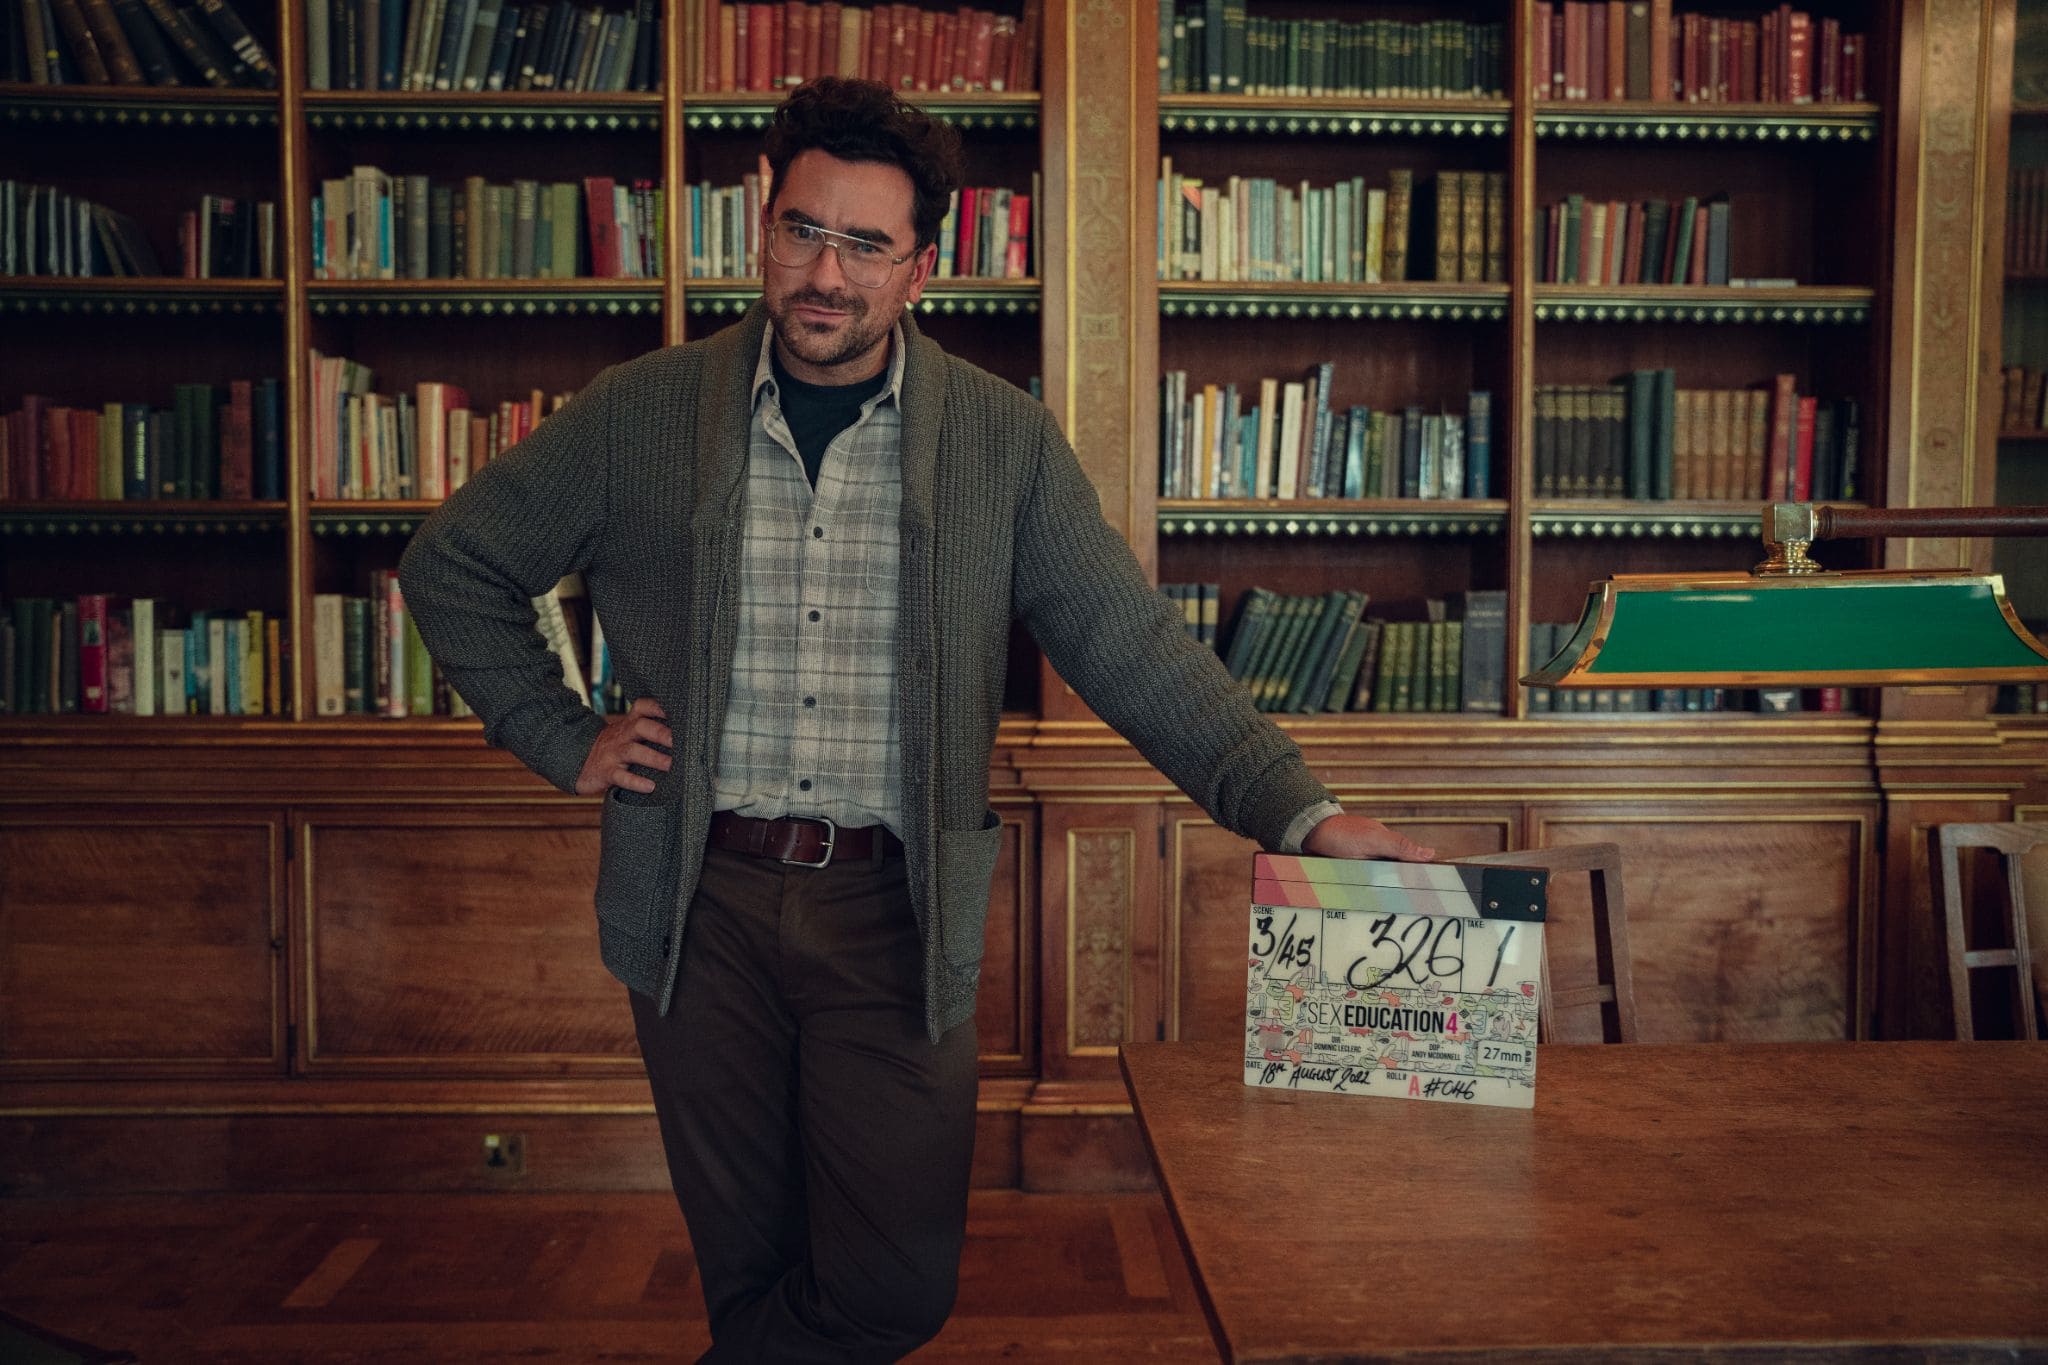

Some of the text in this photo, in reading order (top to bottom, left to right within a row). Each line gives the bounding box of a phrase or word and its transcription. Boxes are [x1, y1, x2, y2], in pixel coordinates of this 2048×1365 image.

[1347, 913, 1464, 990] 326
[1307, 1001, 1458, 1035] SEX EDUCATION 4
[1483, 1046, 1522, 1062] 27mm
[1333, 1067, 1371, 1091] 2022
[1408, 1075, 1420, 1096] A
